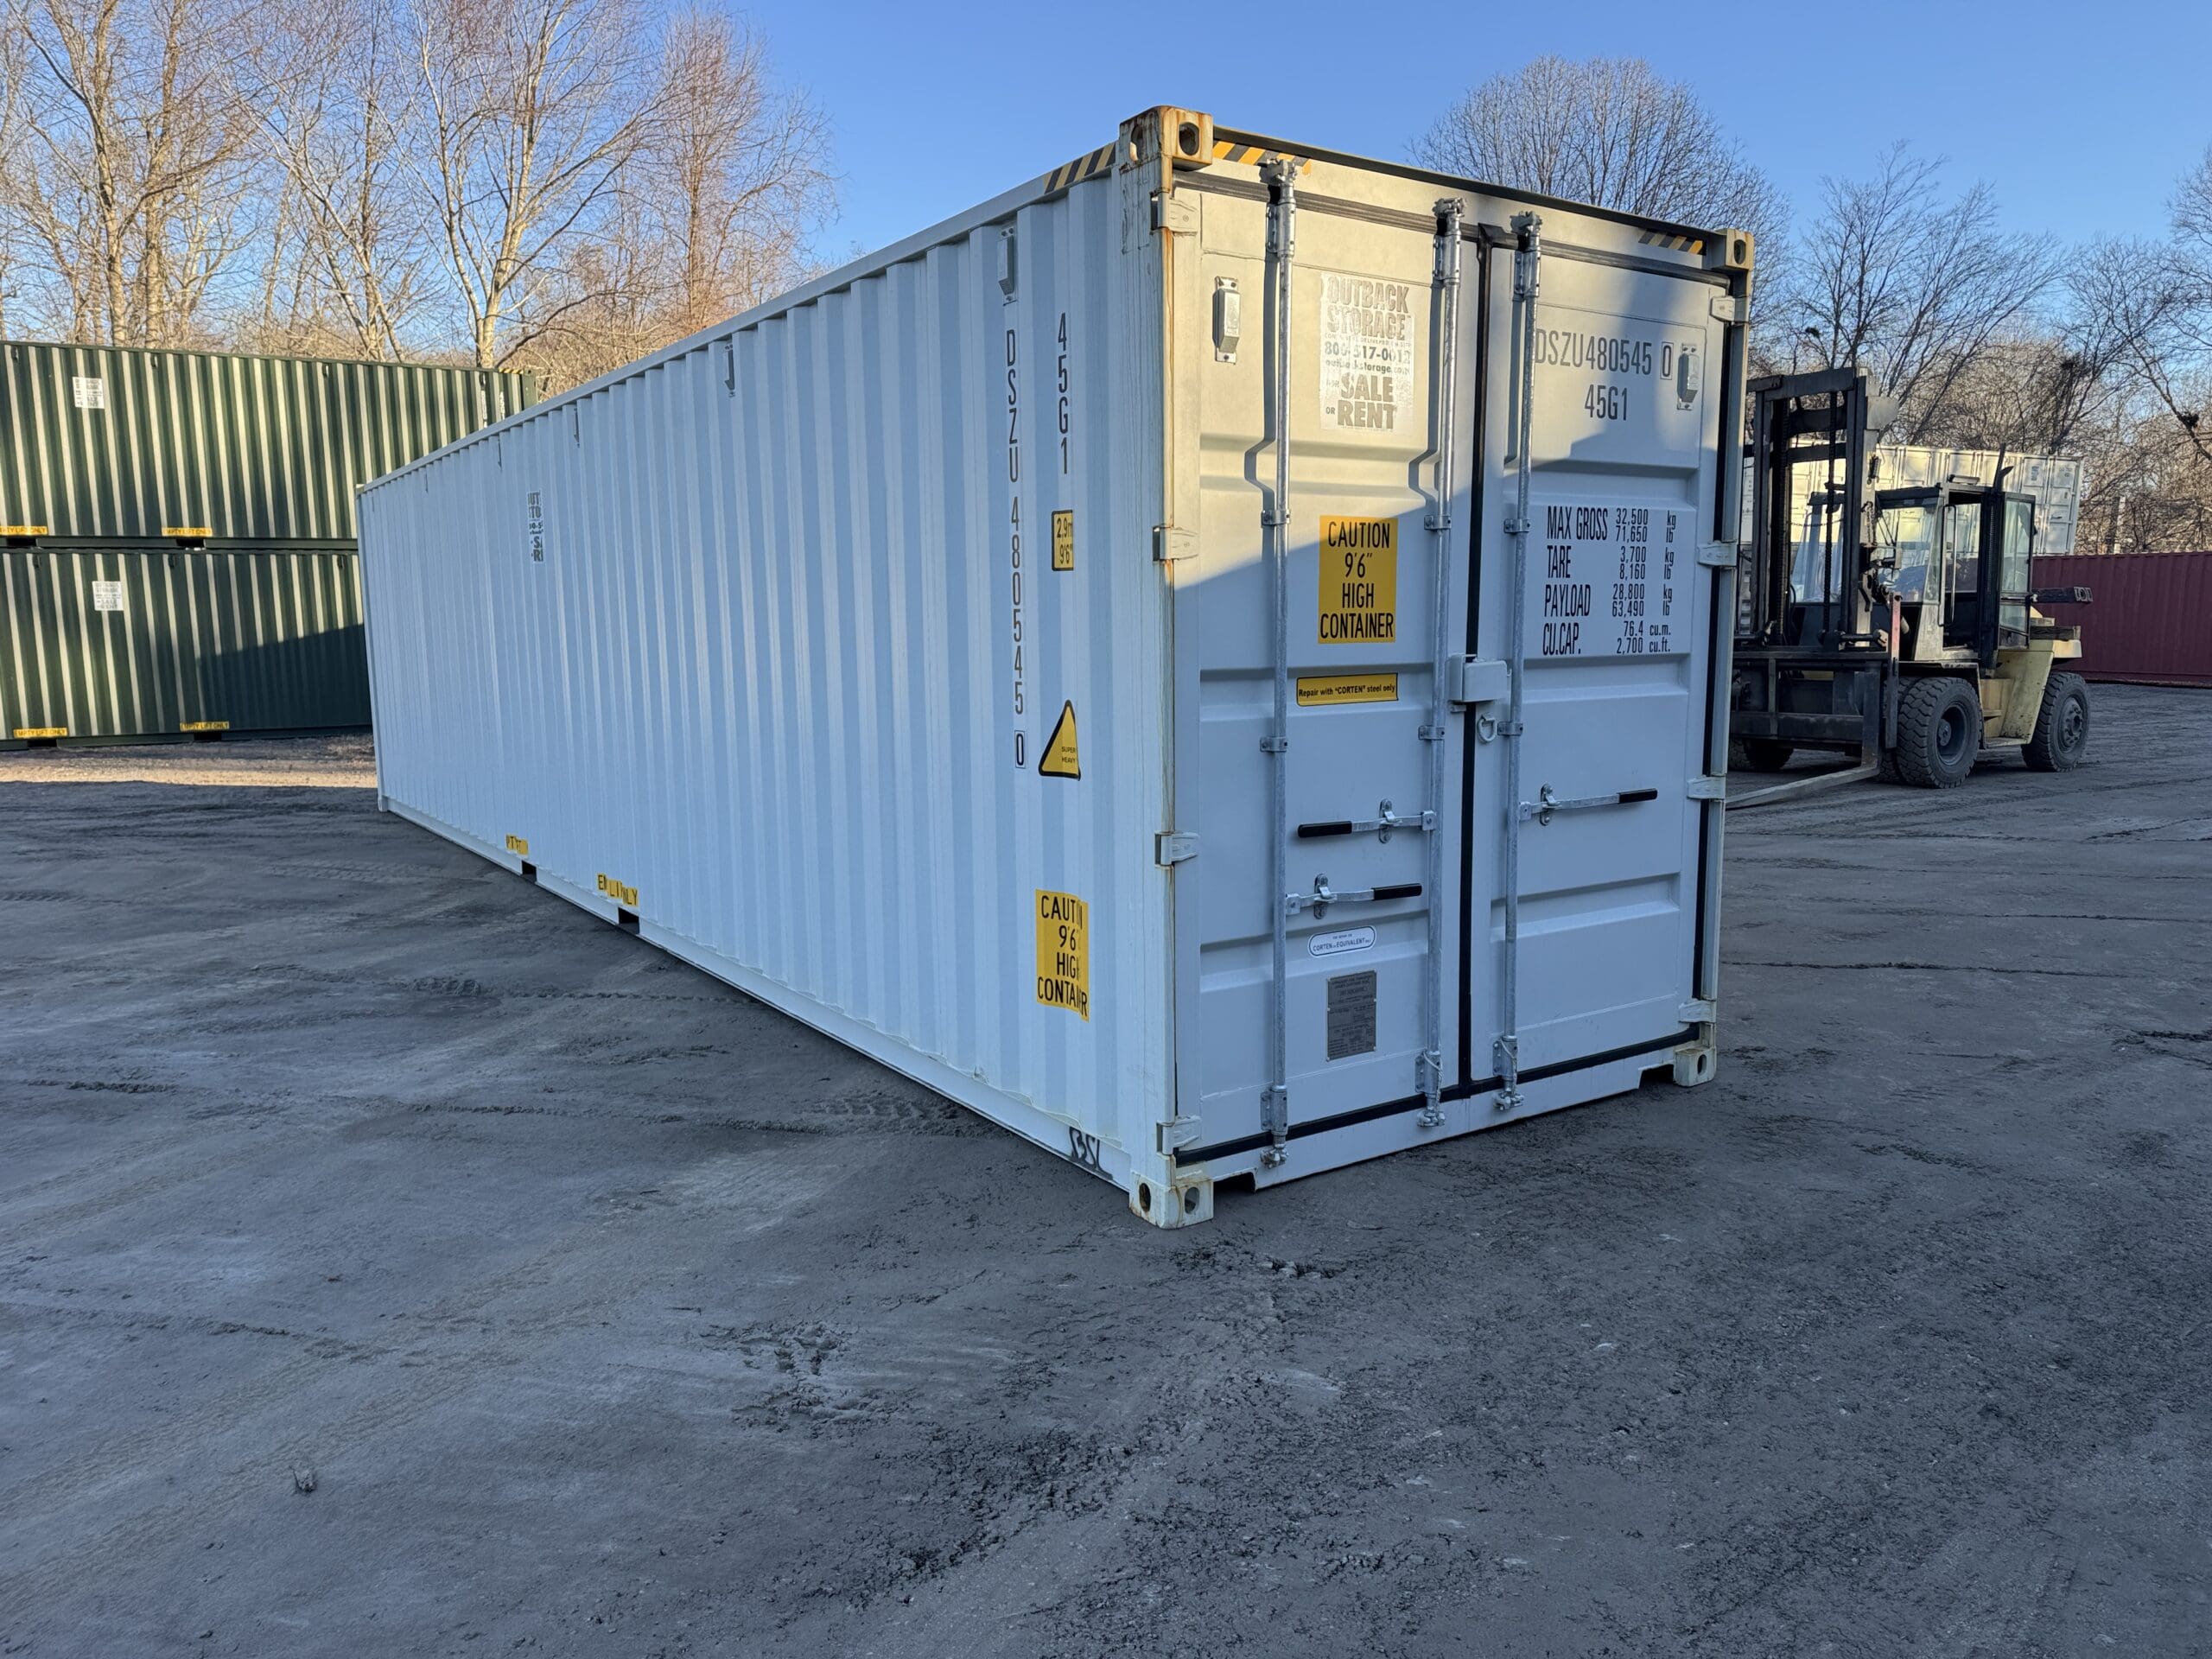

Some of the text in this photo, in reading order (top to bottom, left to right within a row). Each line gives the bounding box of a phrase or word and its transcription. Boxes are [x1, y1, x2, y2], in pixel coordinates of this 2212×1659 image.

[1326, 276, 1409, 314] OUTBACK
[1326, 305, 1406, 341] STORAGE
[1661, 343, 1673, 378] 0
[1058, 313, 1068, 474] 45G1
[1341, 372, 1394, 402] SALE
[1325, 400, 1397, 429] OR RENT
[1585, 384, 1628, 421] 45G1
[1328, 521, 1390, 548] CAUTION
[1547, 505, 1676, 540] MAX GROSS 32,500 kg
[1616, 525, 1674, 543] 71,650 lb
[1007, 329, 1025, 766] DSZU 480545 0
[1547, 545, 1675, 578] TARE 3,700 kg
[1619, 563, 1671, 581] 8,160 lb
[1342, 583, 1375, 608] HIGH
[1544, 583, 1673, 617] PAYLOAD 28,800 kg
[1611, 601, 1670, 618] 63,490 lb
[1320, 613, 1394, 639] CONTAINER
[1542, 620, 1671, 655] CU.CAP. 76.4 cu.m.
[1617, 637, 1671, 655] 2,700 cu.ft.
[1299, 689, 1319, 698] Repair
[1367, 684, 1382, 693] steel
[1383, 683, 1395, 693] only
[1313, 943, 1334, 952] CORTEN
[1336, 938, 1365, 948] EQUIVALENT
